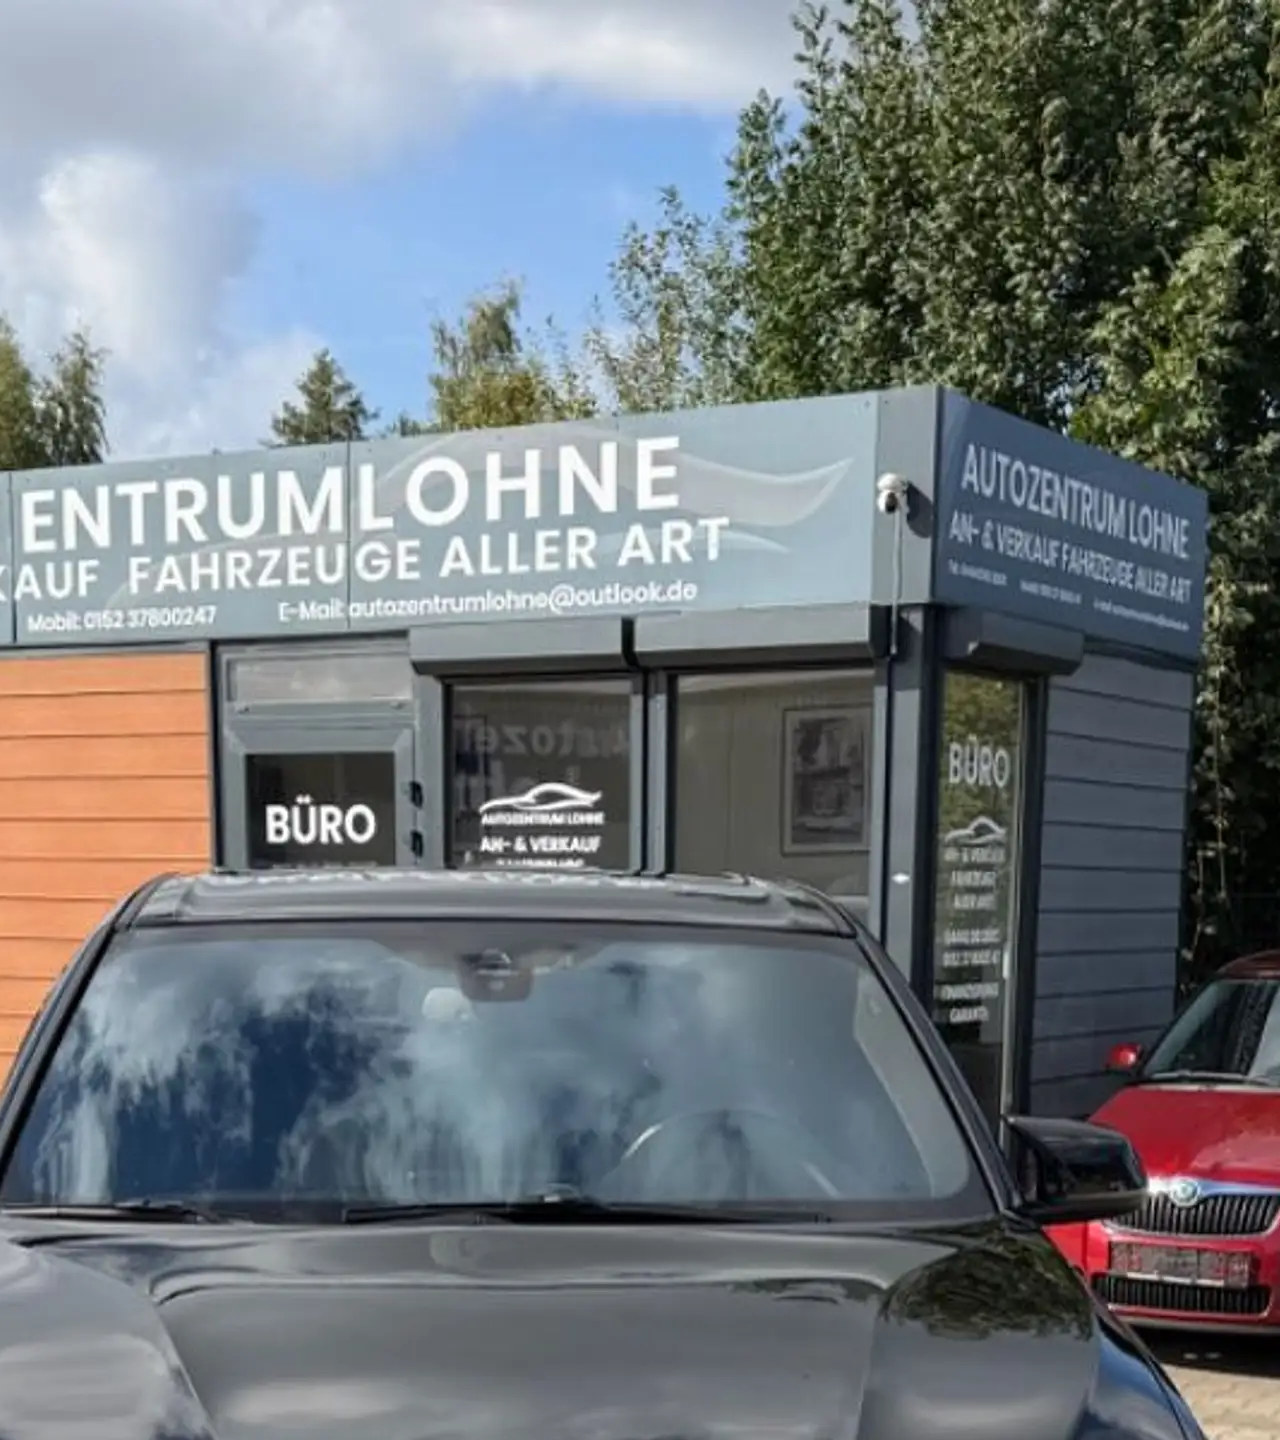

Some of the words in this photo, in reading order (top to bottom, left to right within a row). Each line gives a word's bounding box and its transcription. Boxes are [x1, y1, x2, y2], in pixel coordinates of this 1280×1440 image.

[960, 444, 1126, 540] AUTOZENTRUM
[1129, 499, 1190, 560] LOHNE
[128, 539, 420, 594] FAHRZEUGE
[438, 528, 598, 578] ALLER
[617, 516, 730, 567] ART
[997, 523, 1061, 569] VERKAUF
[1061, 540, 1134, 591] FAHRZEUGE
[948, 733, 1011, 788] BÜRO
[265, 793, 376, 845] BÜRO
[529, 834, 602, 853] VERKAUF
